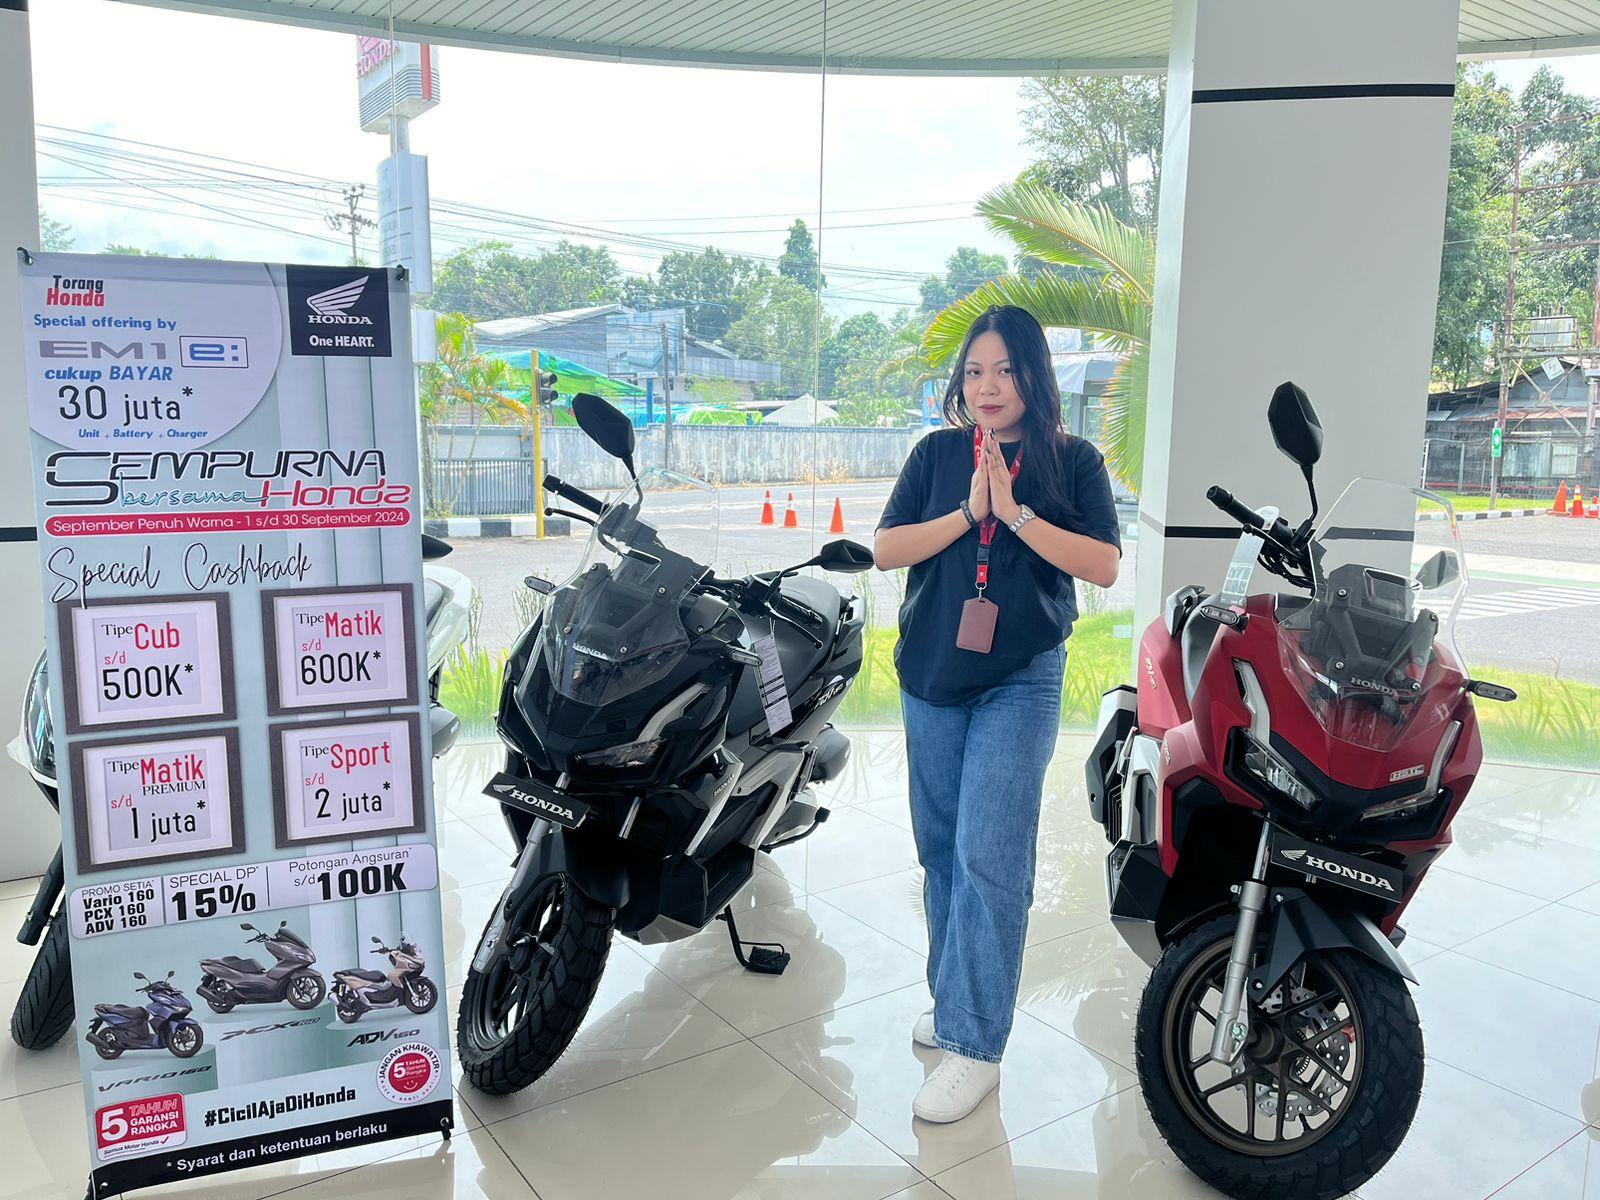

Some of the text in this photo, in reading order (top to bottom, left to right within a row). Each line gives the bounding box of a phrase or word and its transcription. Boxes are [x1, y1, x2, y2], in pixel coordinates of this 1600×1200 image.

[53, 275, 104, 293] Torang
[46, 288, 105, 306] Honda
[34, 314, 177, 331] Special offering by
[307, 314, 374, 325] HONDA
[39, 340, 167, 360] EM1
[309, 335, 375, 348] One HEART.
[44, 366, 173, 382] cukup BAYAR
[58, 385, 108, 420] 30
[78, 428, 100, 438] Unit
[113, 428, 154, 440] Battery
[166, 428, 208, 439] Charger
[45, 450, 386, 506] SEMPURNA
[118, 472, 412, 507] bersama Honda
[53, 519, 135, 534] September
[138, 517, 184, 530] Penuh
[187, 516, 234, 529] Warna
[245, 516, 251, 526] 1
[256, 514, 279, 527] s/d
[283, 513, 299, 526] 30
[302, 512, 372, 527] September
[374, 511, 404, 524] 2024
[48, 542, 312, 609] Special Cashback
[296, 610, 382, 638] Tipe Matik
[101, 621, 180, 650] Tipe Cub
[302, 638, 322, 652] s/d
[104, 651, 126, 665] s/d
[1350, 677, 1398, 697] HONDA
[301, 741, 391, 774] Tipe Sport
[108, 754, 204, 785] Tipe Matik
[305, 772, 325, 786] s/d
[142, 780, 206, 796] PREMIUM
[111, 794, 133, 809] s/d
[315, 788, 331, 819] 2
[509, 788, 574, 820] HONDA
[131, 807, 139, 839] 1
[289, 857, 348, 873] Potongan
[1306, 855, 1395, 892] HONDA
[169, 871, 232, 889] SPECIAL
[294, 862, 407, 901] s/d 100K
[81, 885, 121, 898] PROMO
[83, 888, 155, 910] Vario 160
[85, 902, 145, 922] PCX 160
[171, 883, 257, 922] 15%
[86, 914, 147, 935] ADV 160
[379, 1044, 440, 1079] JANGAN KHAWATIR
[394, 1062, 406, 1078] 5
[129, 1098, 177, 1117] TAHUN
[204, 1086, 356, 1127] #CicilAjaDiHonda
[101, 1108, 128, 1141] 5
[130, 1111, 179, 1126] GARANSI
[131, 1120, 177, 1136] RANGKA
[176, 1121, 387, 1171] Syarat dan ketentuan berlaku
